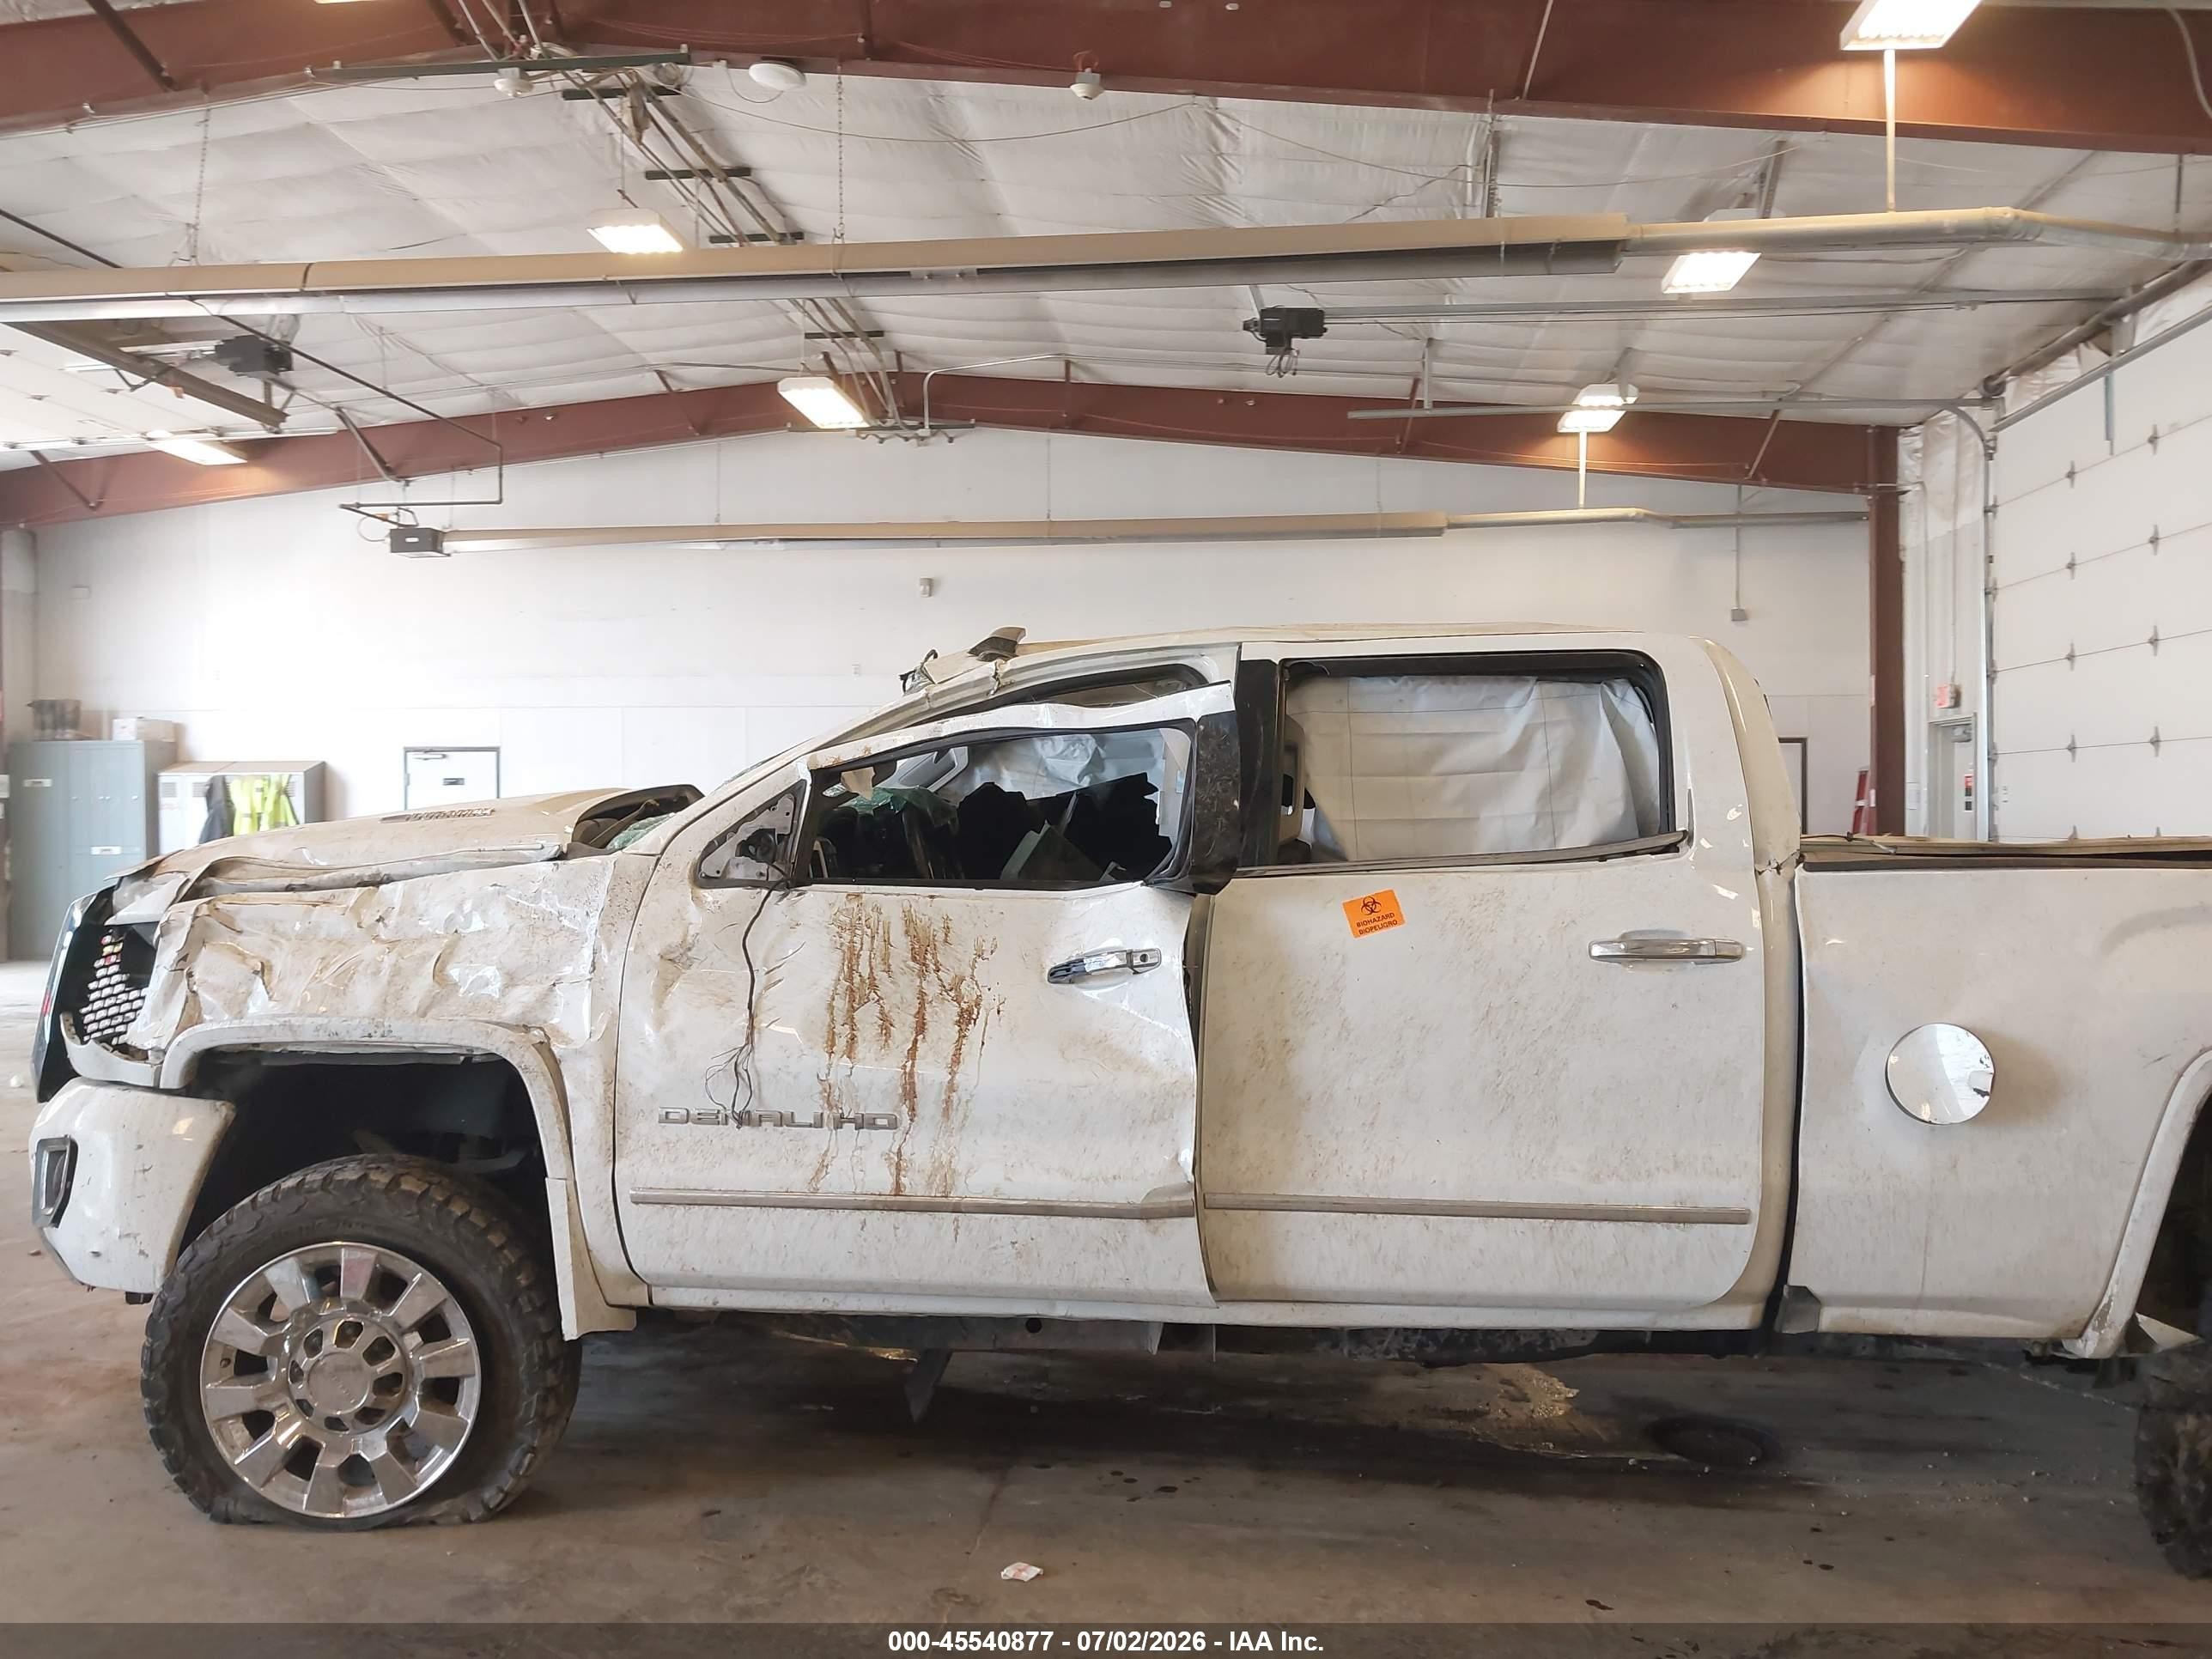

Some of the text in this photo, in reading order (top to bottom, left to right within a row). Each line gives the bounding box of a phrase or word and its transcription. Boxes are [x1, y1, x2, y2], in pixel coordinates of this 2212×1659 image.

[1357, 912, 1395, 927] BIOHAZARD
[1358, 920, 1398, 935] BIOPELIGRO
[659, 1106, 898, 1131] DENALI HD
